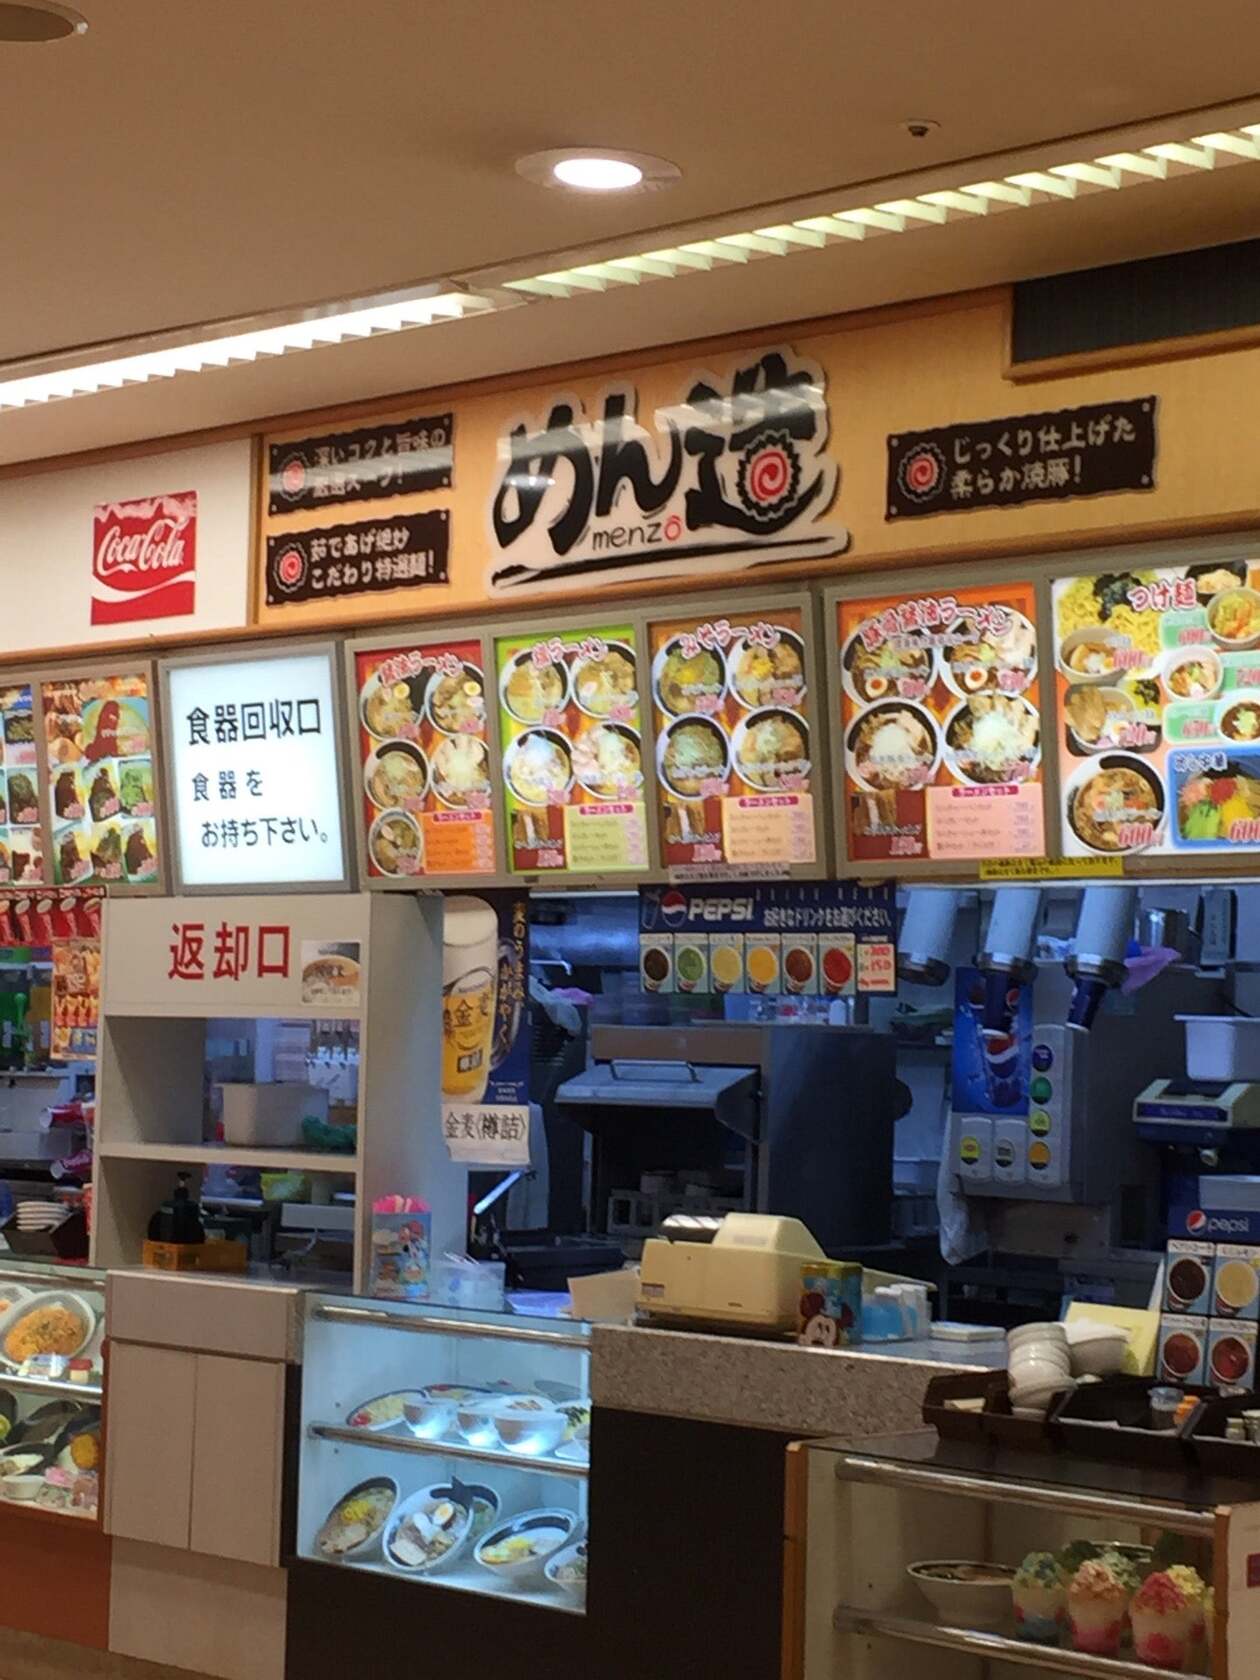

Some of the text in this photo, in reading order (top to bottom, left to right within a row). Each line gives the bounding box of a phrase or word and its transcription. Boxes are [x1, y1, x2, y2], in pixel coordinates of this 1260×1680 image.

[953, 416, 1136, 464] じっくり仕上げた
[1127, 578, 1197, 612] つけ麺
[186, 698, 321, 745] 食器回収口
[191, 769, 263, 802] 食器を
[201, 817, 328, 848] お持ち下さい。
[688, 898, 754, 921] PEPSI
[168, 922, 290, 981] 返却口
[1207, 1217, 1250, 1233] pepsi
